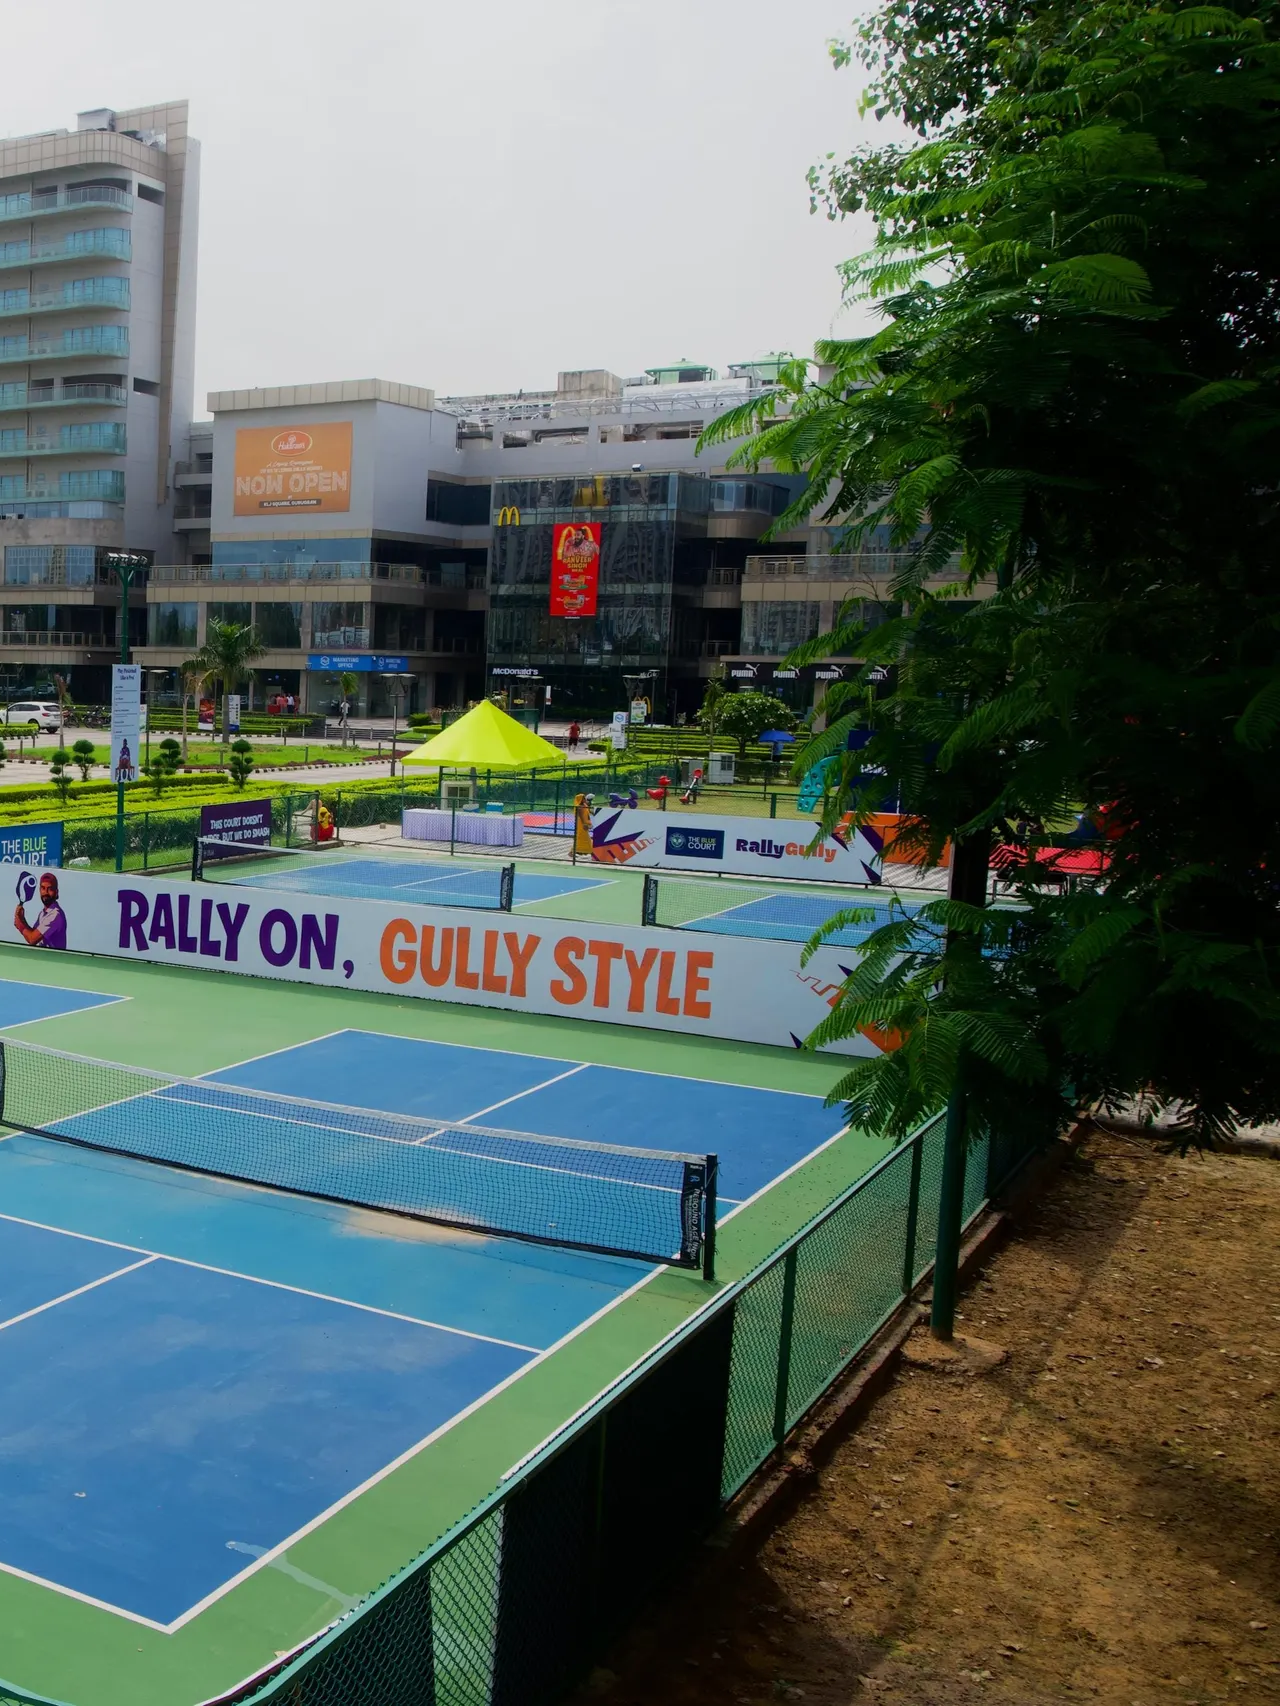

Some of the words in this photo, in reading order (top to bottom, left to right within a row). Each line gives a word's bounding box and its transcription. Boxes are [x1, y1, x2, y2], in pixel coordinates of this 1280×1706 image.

[236, 474, 284, 496] NOW
[289, 471, 347, 493] OPEN
[731, 670, 753, 678] PUMA
[210, 820, 223, 830] THIS
[223, 817, 241, 828] COURT
[222, 831, 233, 842] BUT
[234, 830, 243, 840] WE
[243, 829, 252, 839] DO
[252, 826, 270, 838] SMASH
[1, 839, 21, 854] THE
[23, 836, 47, 852] BLUE
[688, 842, 716, 851] COURT
[117, 889, 250, 962] RALLY
[259, 908, 355, 979] ON,
[379, 917, 541, 998] GULLY
[550, 935, 714, 1019] STYLE
